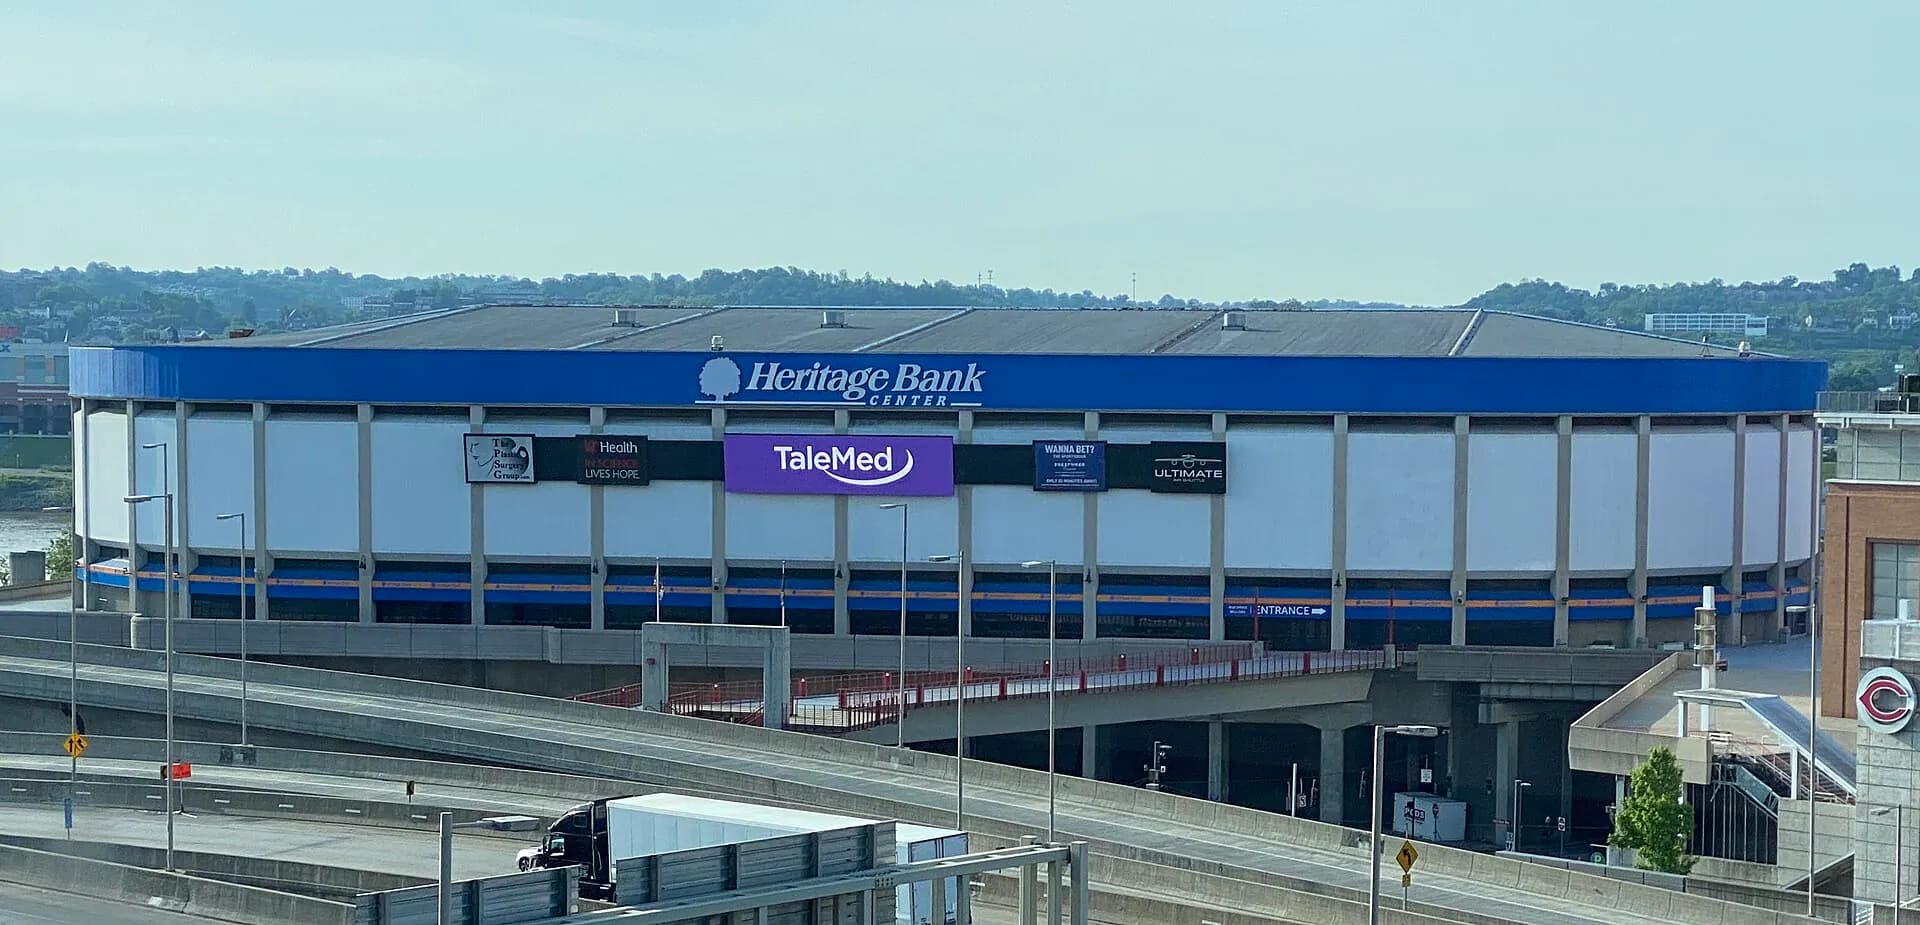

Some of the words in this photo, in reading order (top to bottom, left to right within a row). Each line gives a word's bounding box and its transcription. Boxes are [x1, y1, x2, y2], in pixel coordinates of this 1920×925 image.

[745, 361, 889, 400] Heritage
[891, 362, 987, 392] Bank
[869, 395, 947, 407] CENTER
[600, 441, 638, 453] Health
[1045, 444, 1074, 454] WANNA
[1075, 444, 1095, 454] BET?
[774, 445, 893, 471] TaleMed
[494, 460, 524, 470] Surgery
[586, 468, 610, 479] LIVES
[612, 469, 640, 480] HOPE
[1154, 469, 1223, 478] ULTIMATE
